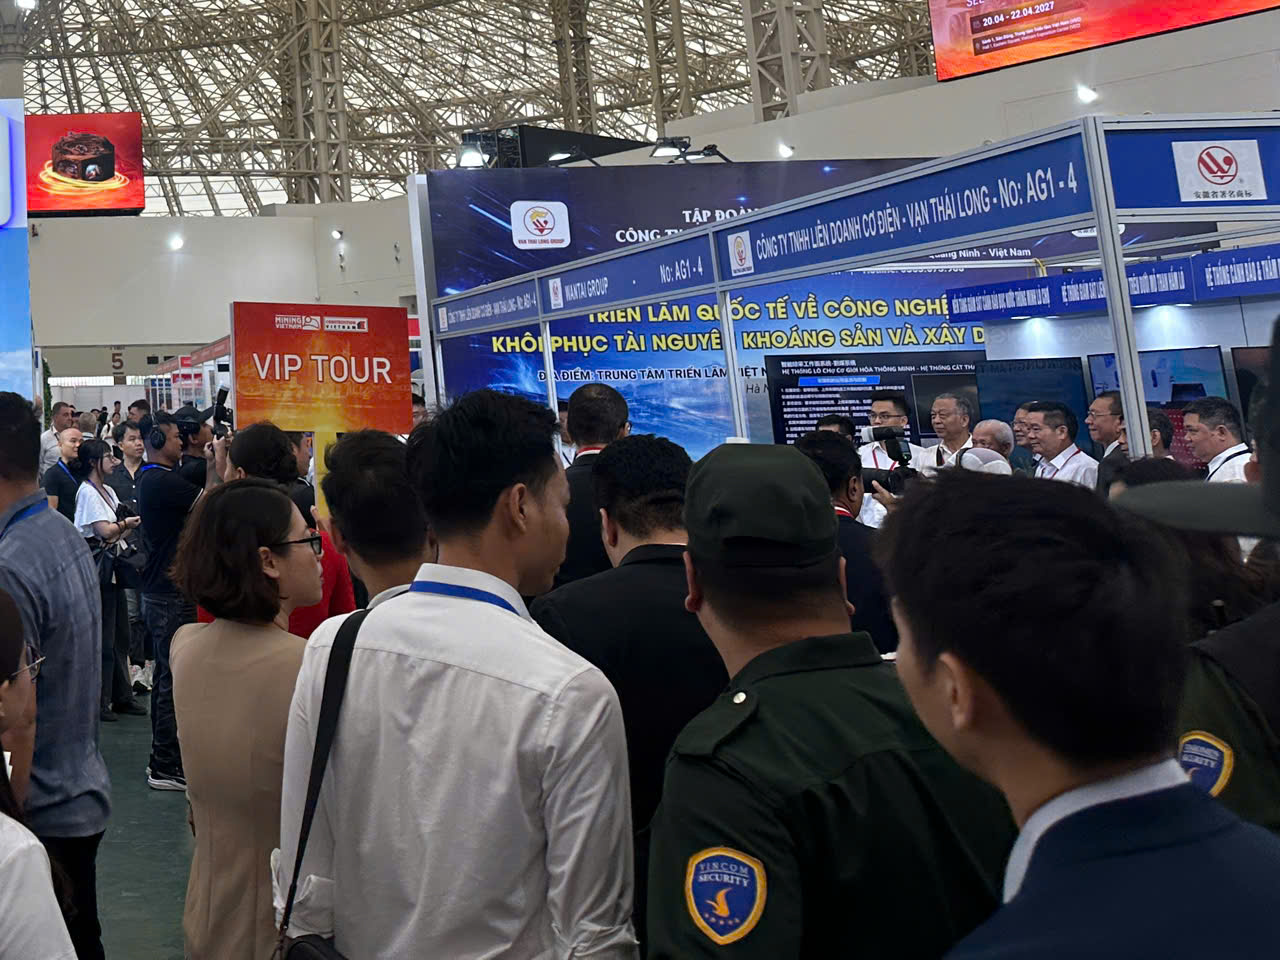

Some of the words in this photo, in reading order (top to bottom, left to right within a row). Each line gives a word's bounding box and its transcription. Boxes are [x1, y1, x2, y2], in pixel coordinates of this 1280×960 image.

[982, 16, 1004, 27] 20.04
[1010, 1, 1055, 21] 22.04.2027
[682, 207, 711, 223] TẬP
[756, 236, 779, 261] CÔNG
[779, 234, 789, 256] TY
[788, 230, 811, 255] TNHH
[812, 222, 830, 250] LIÊN
[830, 218, 861, 246] DOANH
[862, 214, 878, 239] CƠ
[877, 204, 901, 240] ĐIỆN
[906, 201, 930, 234] VẠN
[930, 194, 956, 226] THÁI
[957, 185, 991, 219] LONG
[1027, 167, 1057, 203] AG1
[1068, 162, 1077, 194] 4
[615, 227, 661, 242] CÔNG
[958, 248, 981, 259] Ninh
[988, 247, 1010, 259] Việt
[1010, 246, 1031, 257] Nam
[565, 279, 588, 302] WANTAI
[588, 276, 609, 299] GROUP
[674, 258, 691, 281] AG1
[697, 256, 703, 276] 4
[648, 302, 690, 321] LÃM
[696, 294, 760, 322] QUỐC
[766, 294, 790, 320] TẾ
[791, 292, 817, 319] VỀ
[823, 295, 889, 318] CÔNG
[895, 292, 949, 320] NGHỆ
[275, 315, 301, 323] MINING
[492, 331, 544, 353] KHÔI
[551, 335, 609, 357] PHỤC
[614, 331, 646, 351] TÀI
[650, 328, 723, 352] NGUYÊ
[743, 324, 835, 349] KHOÁNG
[840, 323, 883, 346] SẢN
[887, 323, 918, 345] VÀ
[923, 322, 968, 344] XÂY
[111, 352, 124, 369] 5
[252, 352, 302, 381] VIP
[310, 355, 392, 384] TOUR
[562, 367, 593, 380] ĐIỂM:
[595, 368, 637, 380] TRUNG
[639, 367, 665, 380] TÂM
[667, 365, 701, 379] TRIỂN
[704, 365, 728, 378] LÃM
[746, 383, 760, 394] Hà
[698, 873, 750, 888] SECURITY
